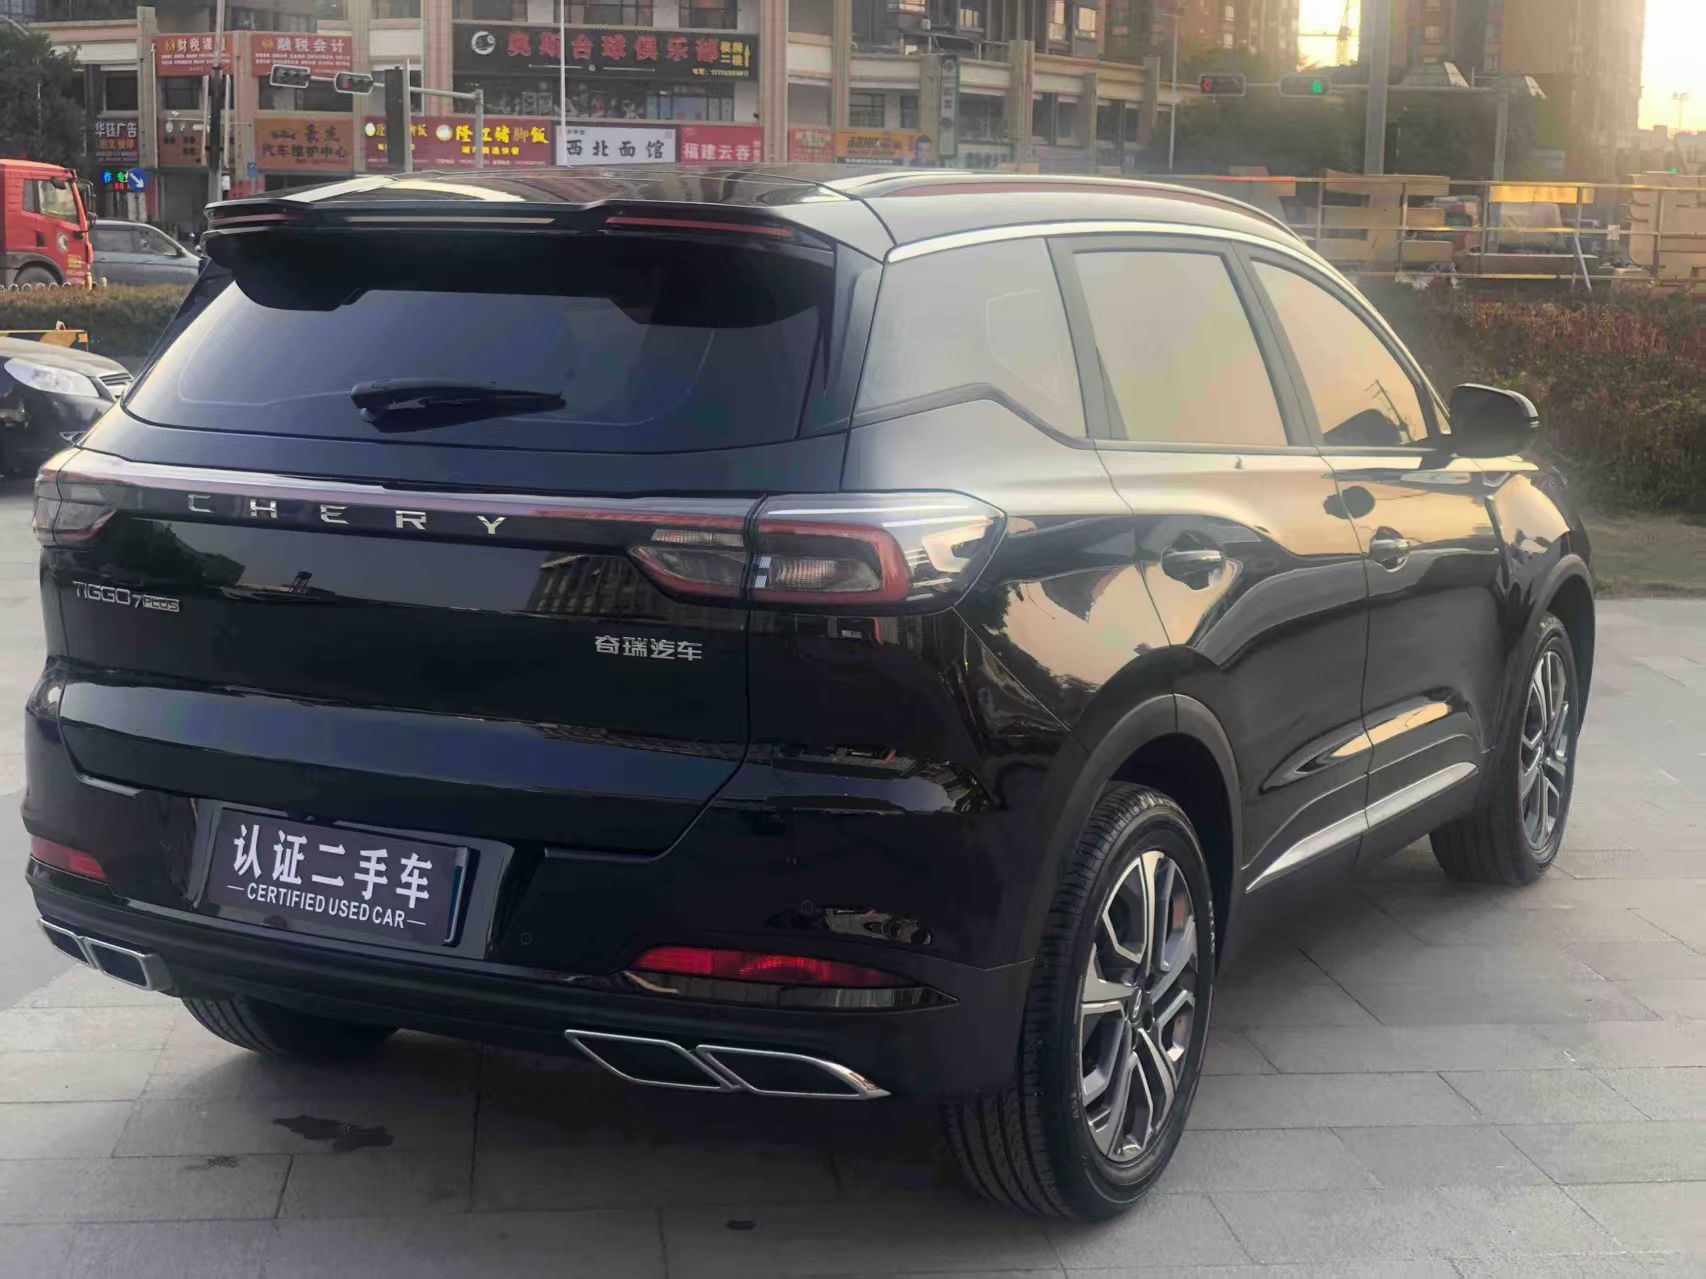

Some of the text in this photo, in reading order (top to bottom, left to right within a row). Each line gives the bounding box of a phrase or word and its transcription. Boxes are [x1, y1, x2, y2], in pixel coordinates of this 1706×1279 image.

[566, 139, 665, 159] 西北面馆
[187, 494, 506, 535] CHERY
[594, 634, 703, 661] 奇瑞汽车
[232, 824, 433, 909] 认证二手车
[246, 882, 406, 929] CERTIFIED USED CAR
